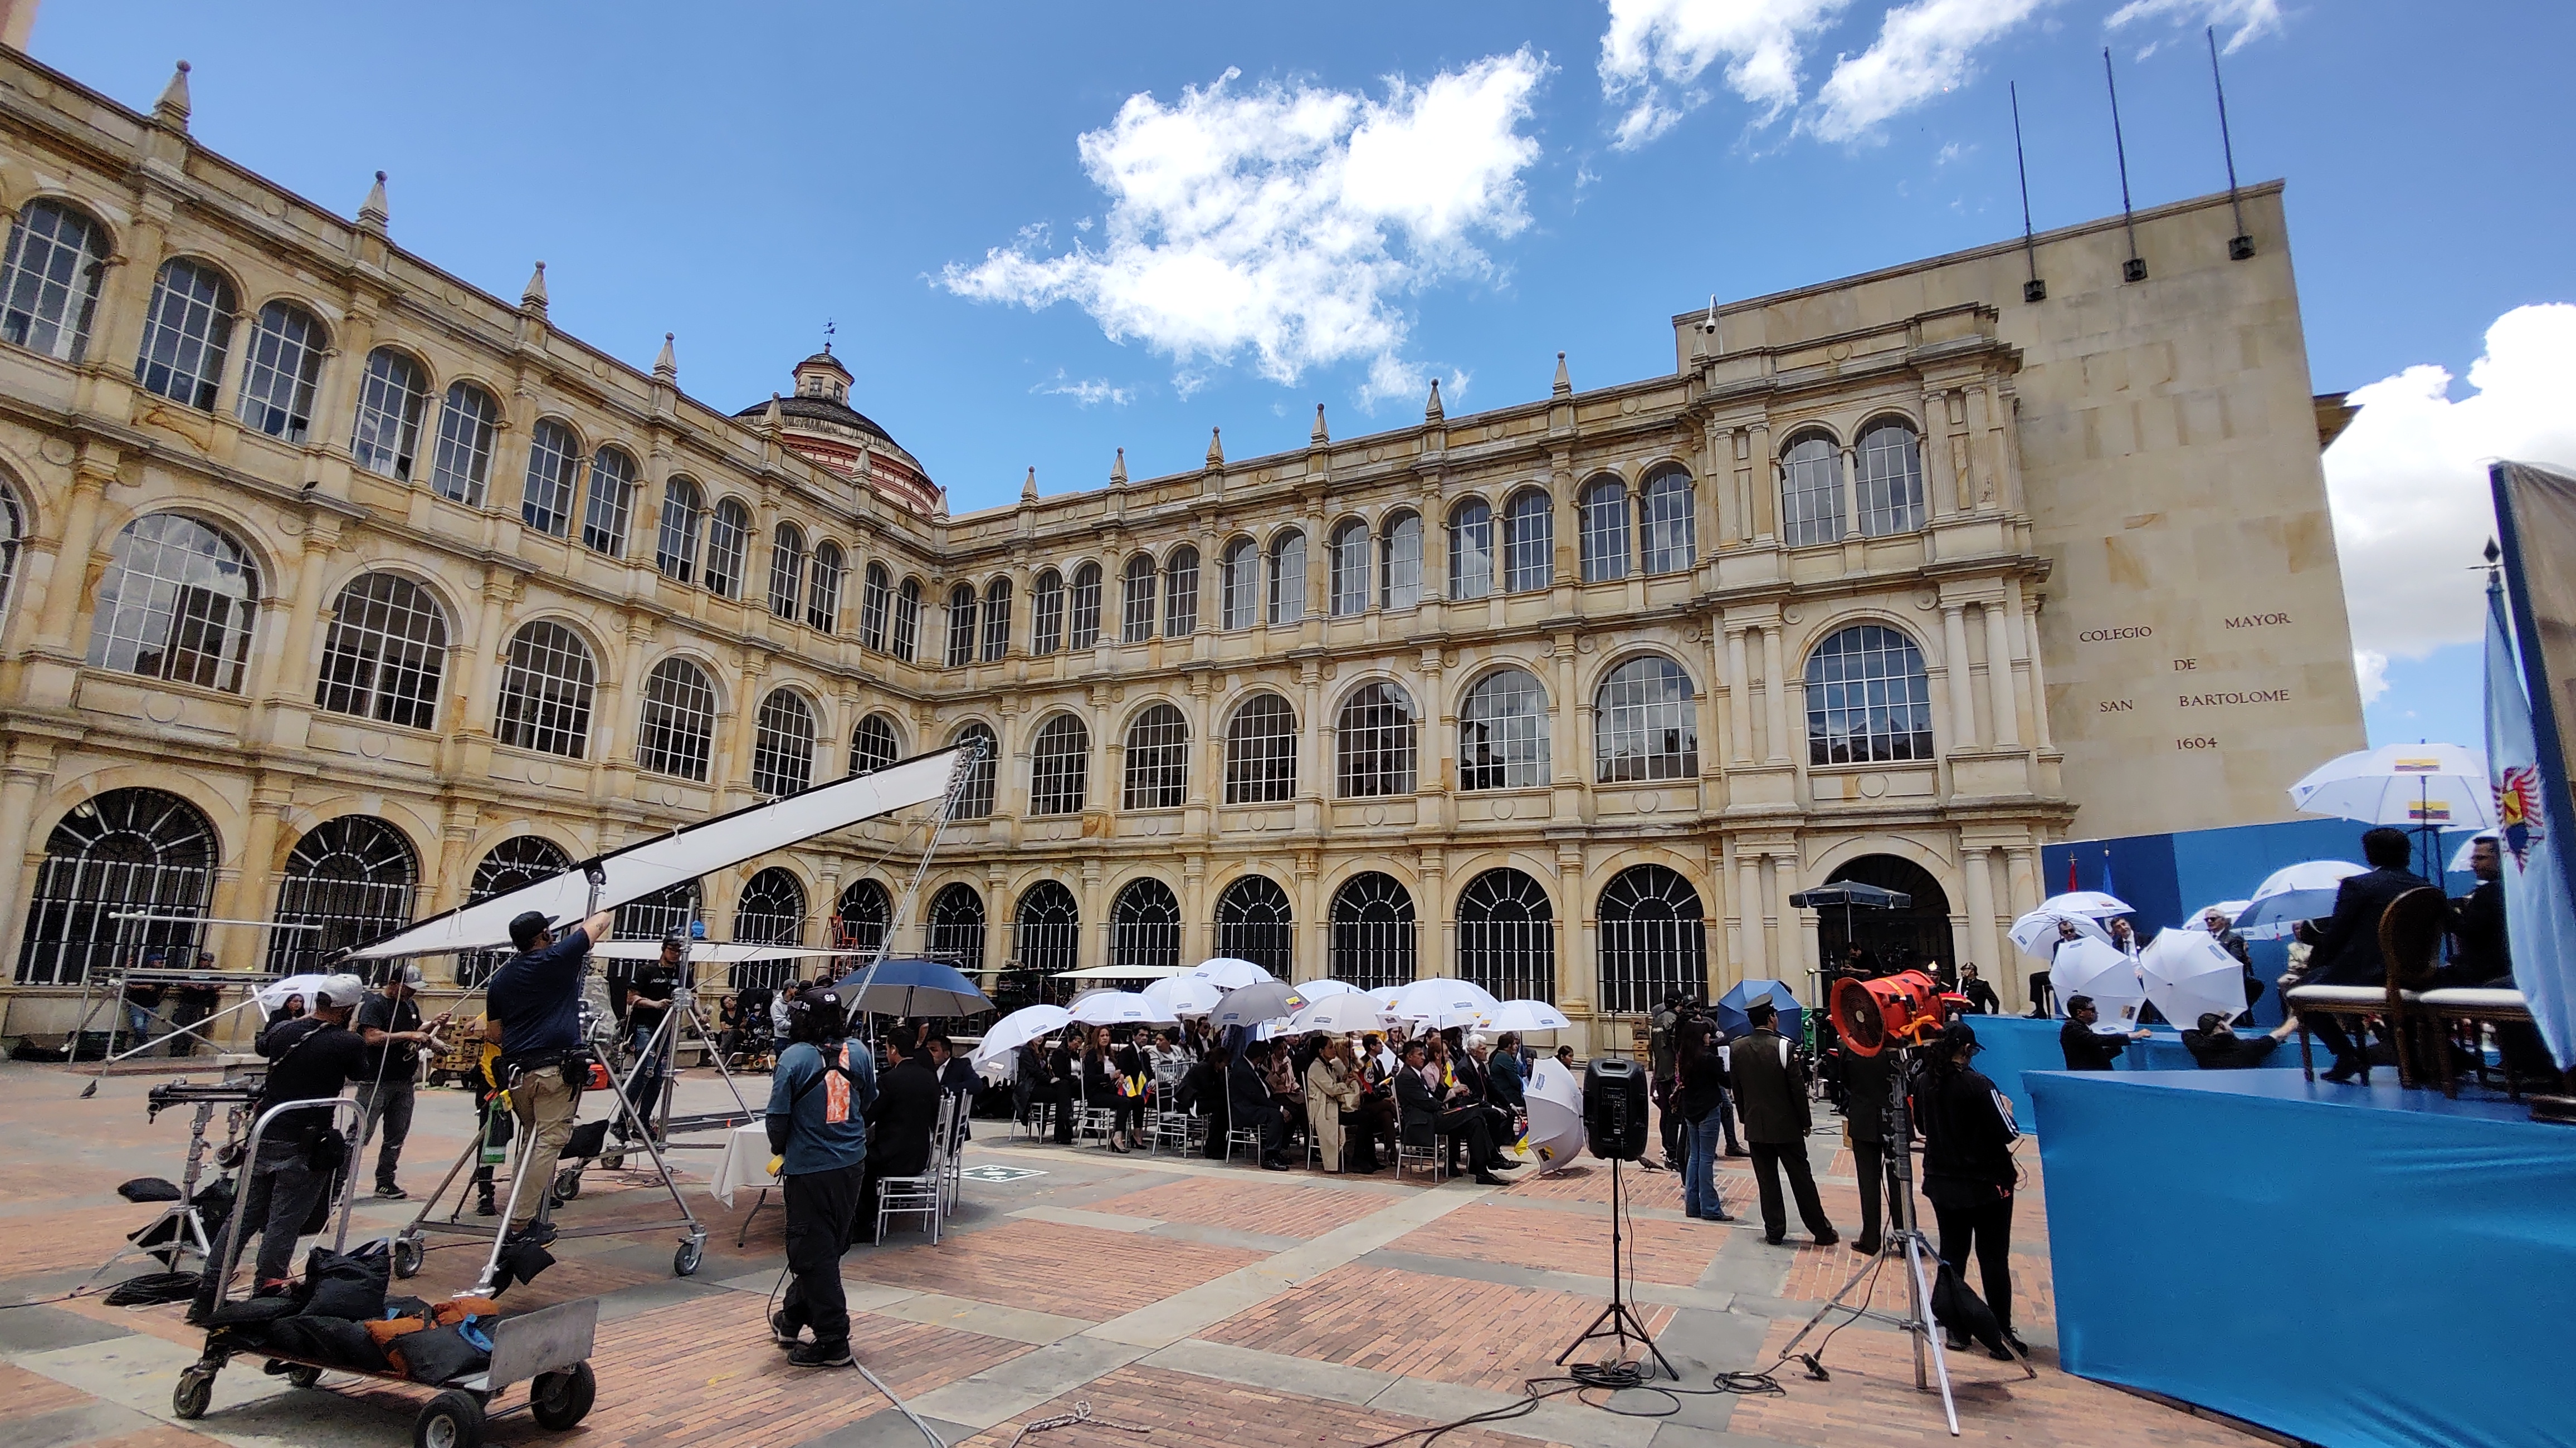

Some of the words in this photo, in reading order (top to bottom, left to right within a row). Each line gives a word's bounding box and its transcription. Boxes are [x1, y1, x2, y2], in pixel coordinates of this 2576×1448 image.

[2080, 627, 2152, 642] COLEGIO
[2226, 613, 2291, 629] MAYOR
[2174, 659, 2197, 671] DE
[2100, 700, 2133, 712] SAN
[2179, 689, 2289, 707] BARTOLOME
[2177, 738, 2217, 750] 1604
